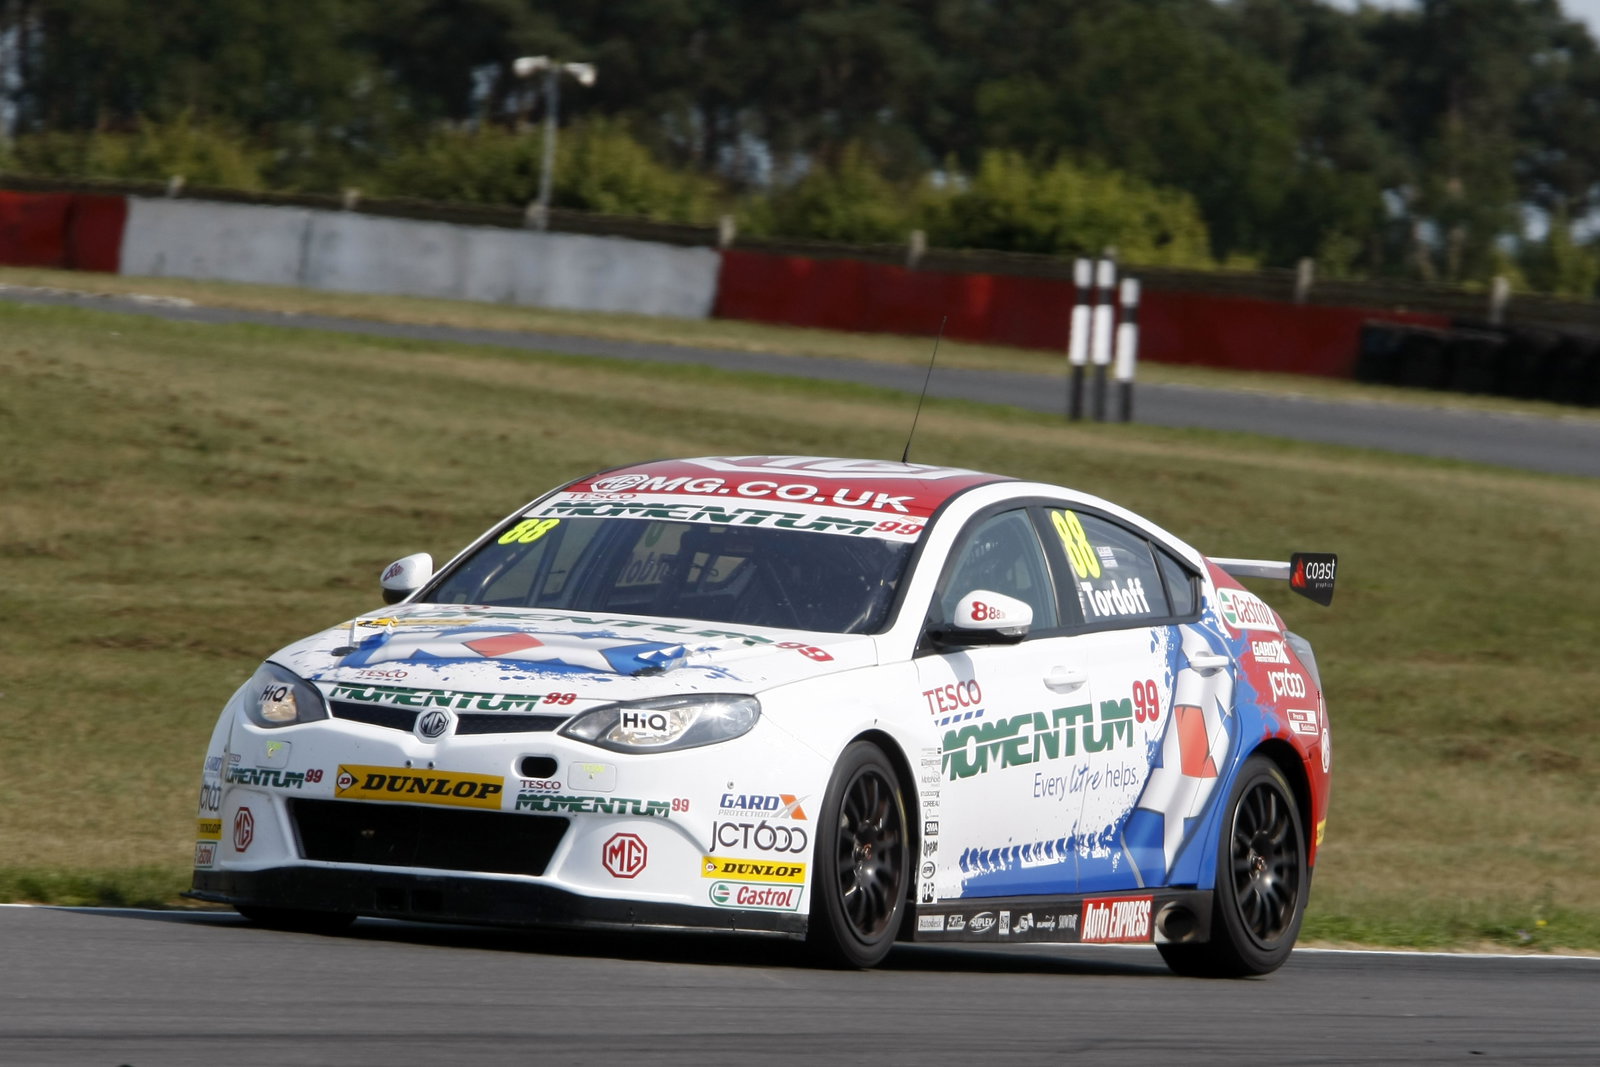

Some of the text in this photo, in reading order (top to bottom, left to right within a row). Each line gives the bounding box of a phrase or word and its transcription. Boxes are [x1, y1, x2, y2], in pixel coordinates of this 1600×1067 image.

[568, 492, 637, 501] TESCO
[637, 476, 915, 513] MG.CO.UK
[497, 518, 561, 545] 88
[538, 502, 925, 535] MOMENTUM 99
[1051, 509, 1101, 579] 88
[1305, 558, 1335, 579] coast
[1080, 577, 1151, 616] Tordoff
[1232, 594, 1274, 626] Castrol
[776, 642, 834, 662] 99
[359, 669, 409, 679] TESCO
[1267, 667, 1306, 703] JCT600
[259, 685, 288, 702] HiQ
[329, 682, 577, 712] MOMENTUM 99
[922, 679, 982, 716] TESCO
[622, 712, 668, 732] HiQ
[940, 679, 1160, 782] MOMENTUM 99
[304, 769, 324, 783] 99
[360, 773, 503, 799] DUNLOP
[520, 779, 562, 790] TESCO
[1033, 761, 1139, 801] Every litre helps.
[515, 794, 690, 817] MOMENTUM 99
[709, 820, 808, 853] JCT600
[721, 863, 803, 877] DUNLOP
[736, 886, 794, 907] Castrol
[1082, 902, 1110, 940] Auto
[1109, 900, 1151, 938] EXPRESS
